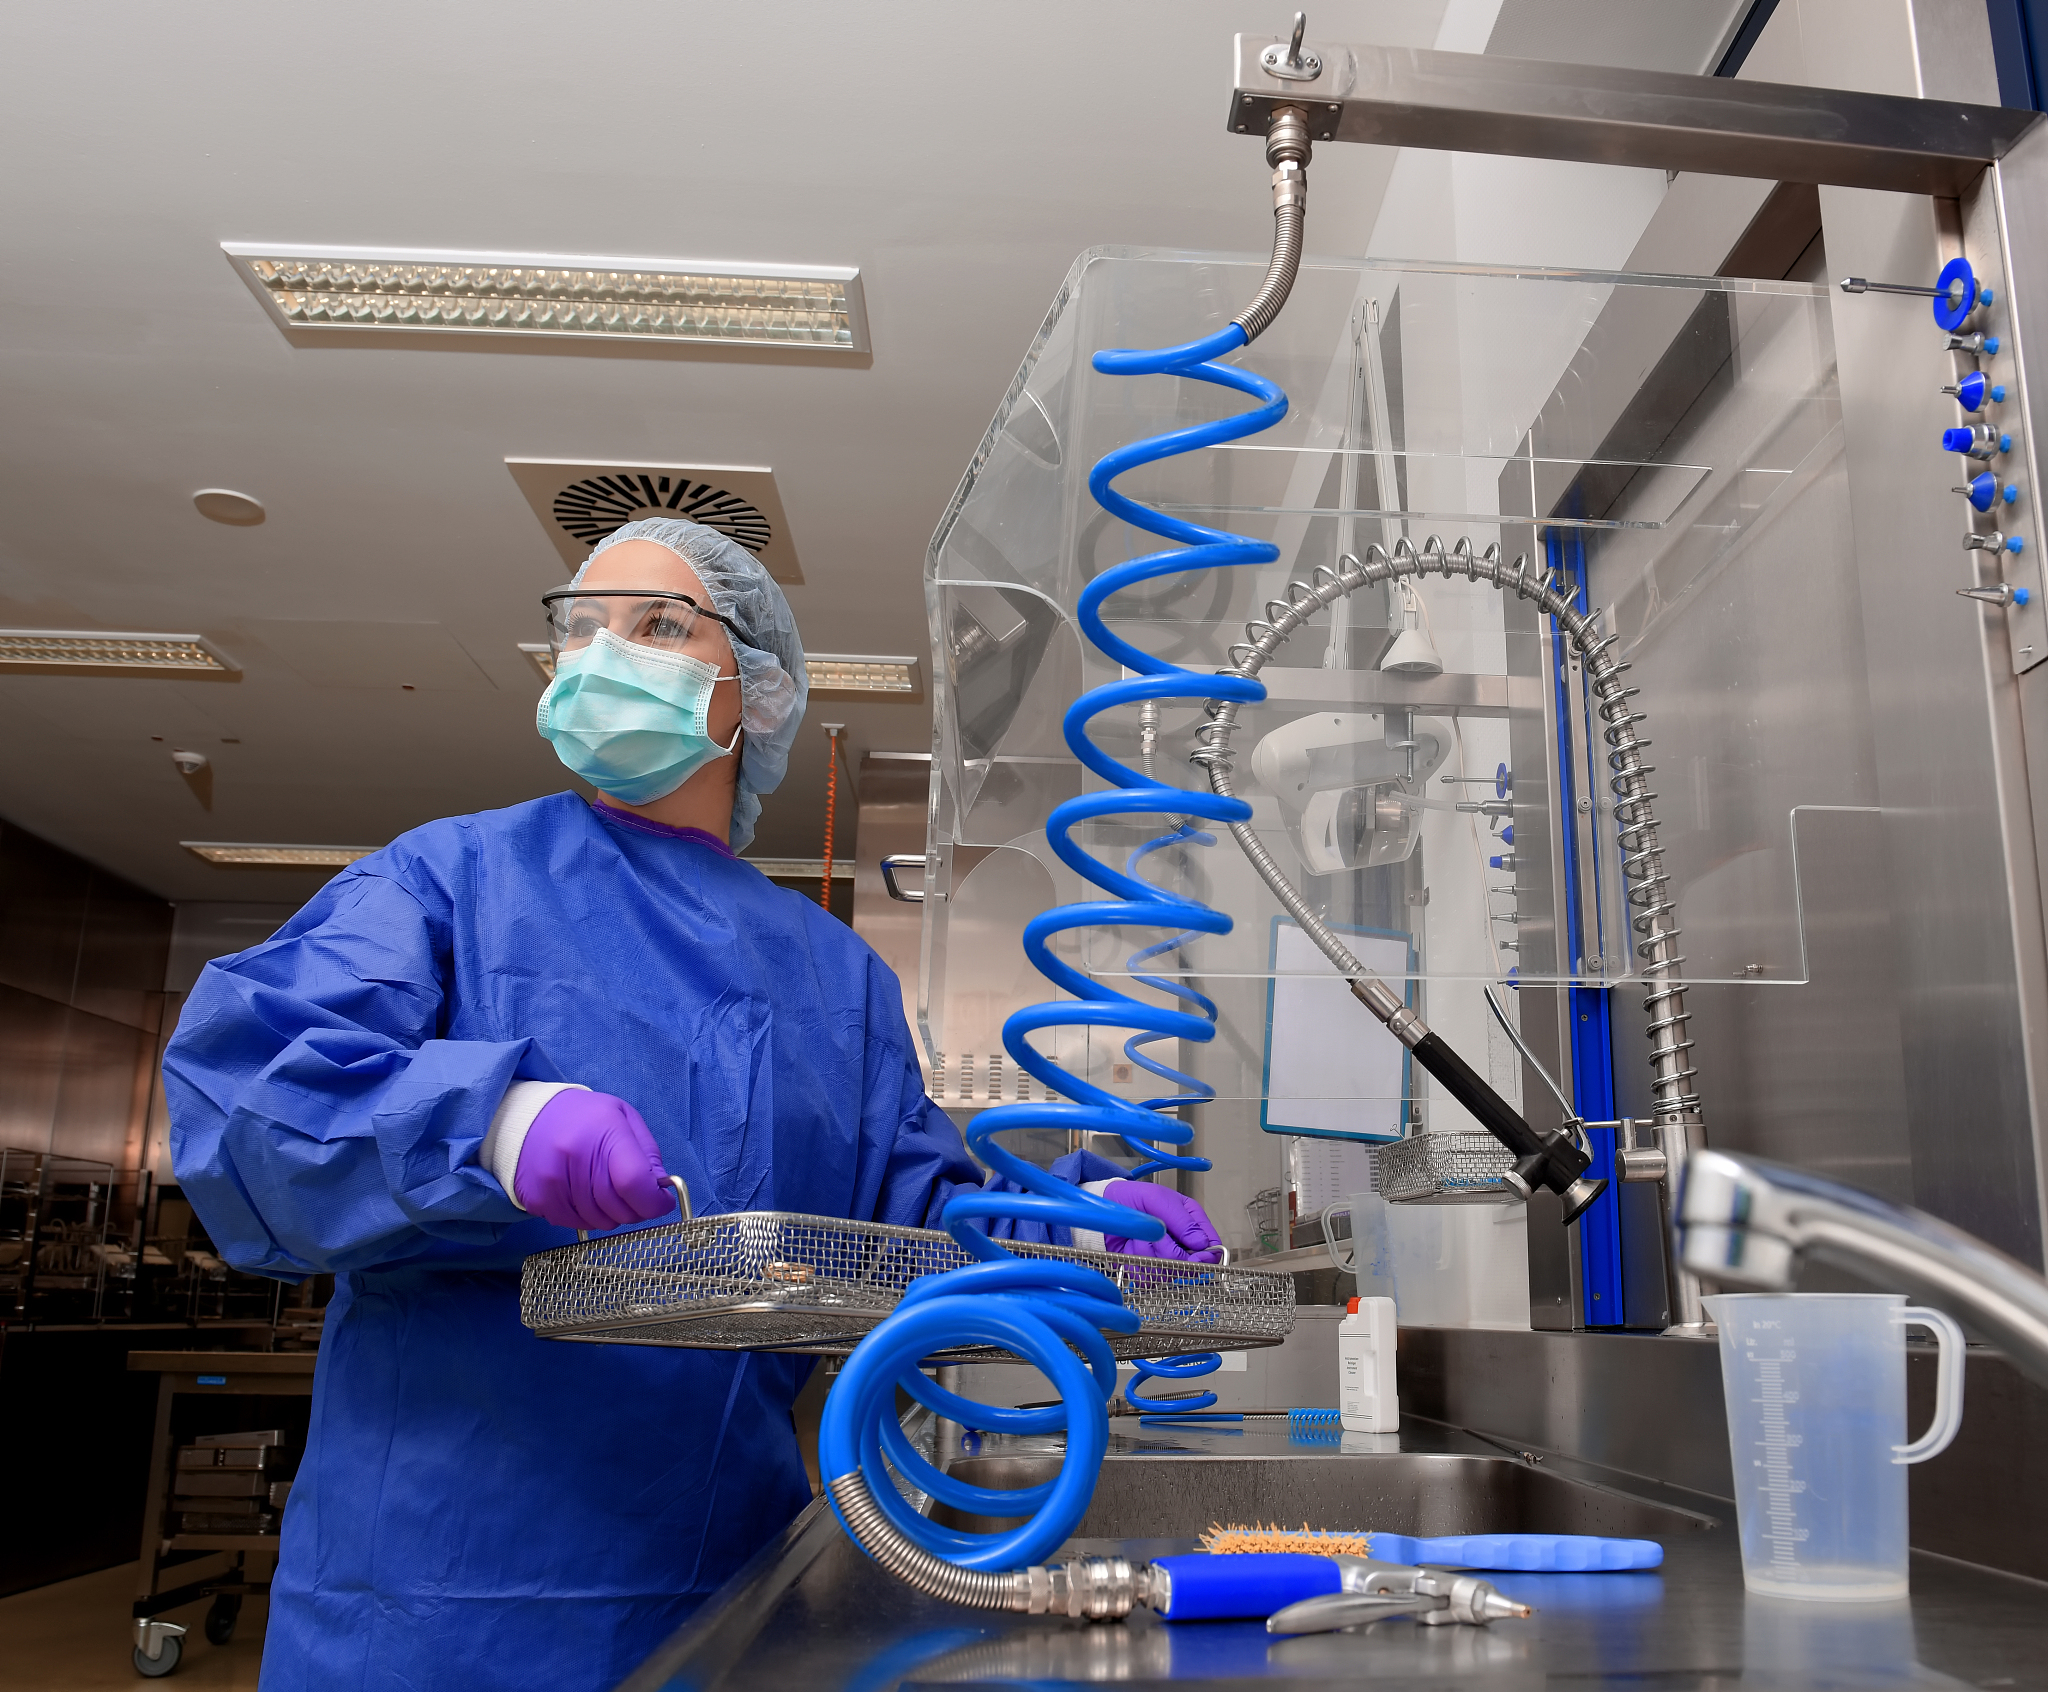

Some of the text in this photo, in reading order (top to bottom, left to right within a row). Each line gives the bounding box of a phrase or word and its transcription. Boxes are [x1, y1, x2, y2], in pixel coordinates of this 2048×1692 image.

[1780, 1350, 1797, 1359] 500
[1783, 1391, 1800, 1400] 400
[1785, 1434, 1803, 1444] 300
[1789, 1480, 1807, 1490] 200
